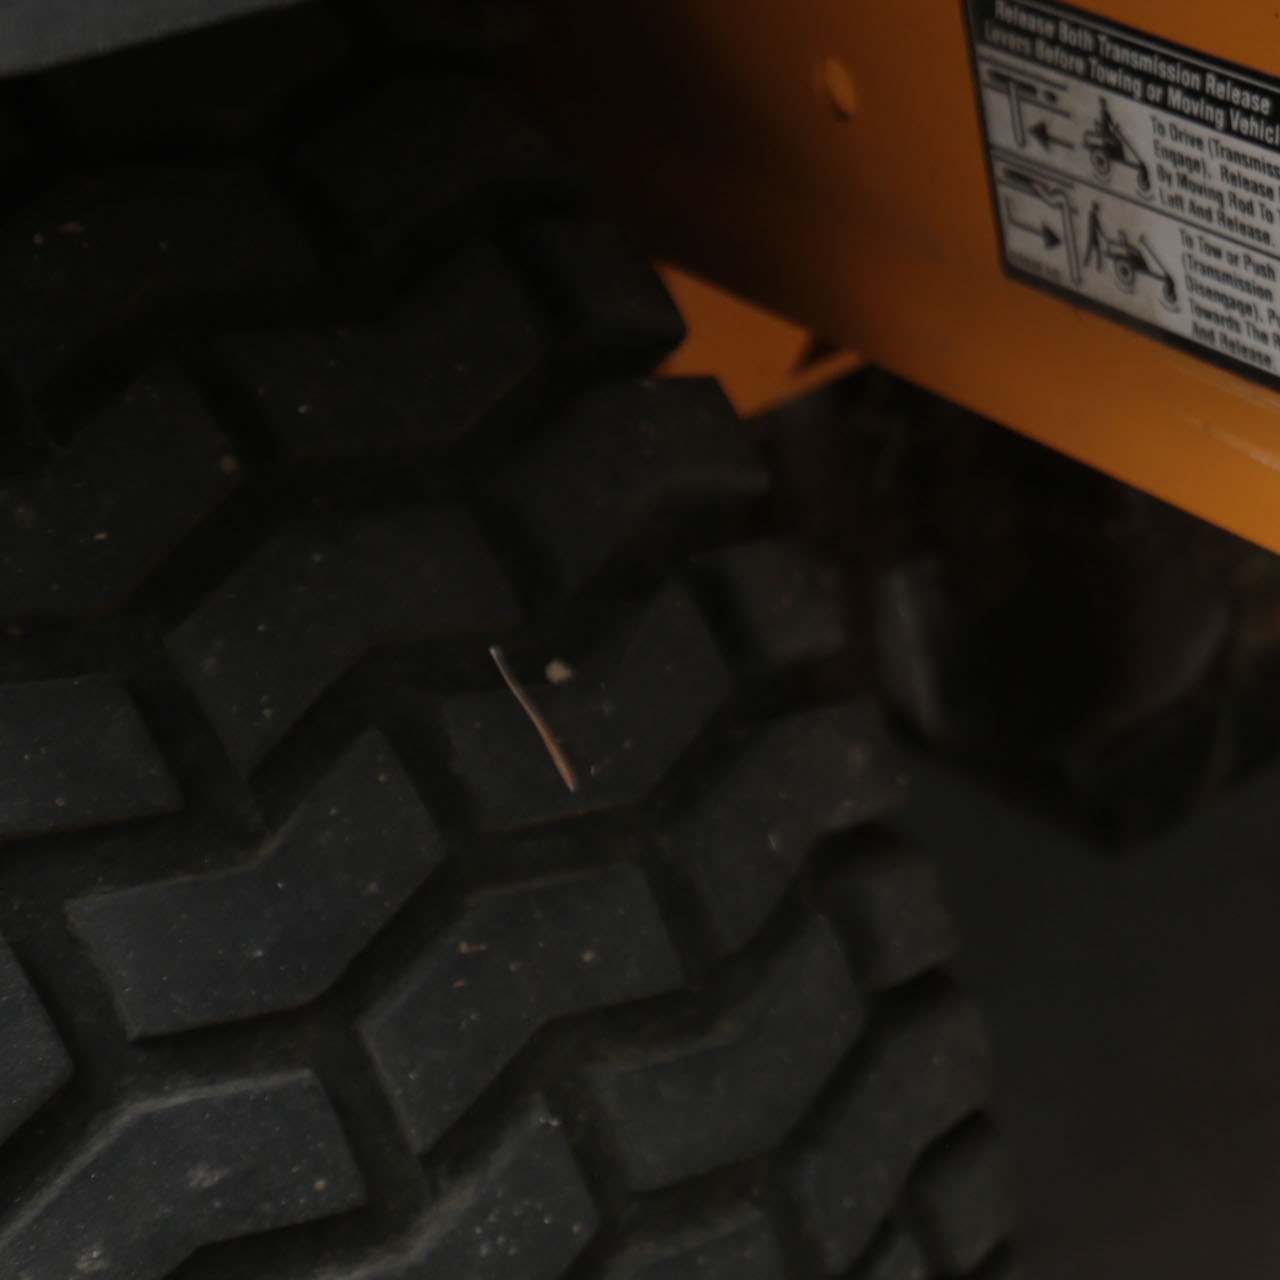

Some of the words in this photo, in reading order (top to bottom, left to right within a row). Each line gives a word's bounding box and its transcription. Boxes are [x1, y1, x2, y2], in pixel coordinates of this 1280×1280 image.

[1035, 38, 1085, 77] Before
[1090, 58, 1144, 102] Towing
[1147, 84, 1163, 104] or
[1168, 87, 1225, 130] Moving
[1059, 21, 1094, 52] Both
[1099, 35, 1200, 92] Transmission
[1205, 73, 1270, 116] Release
[1149, 116, 1166, 136] To
[1168, 123, 1204, 150] Drive
[1175, 172, 1224, 207] Moving
[1226, 191, 1255, 217] Rod
[1259, 203, 1274, 224] To
[1218, 164, 1274, 201] Release
[1179, 229, 1194, 248] To
[1197, 236, 1223, 259] Tow
[1224, 251, 1239, 266] or
[1240, 254, 1276, 281] Push
[1187, 297, 1241, 334] Towards
[1245, 323, 1270, 345] The
